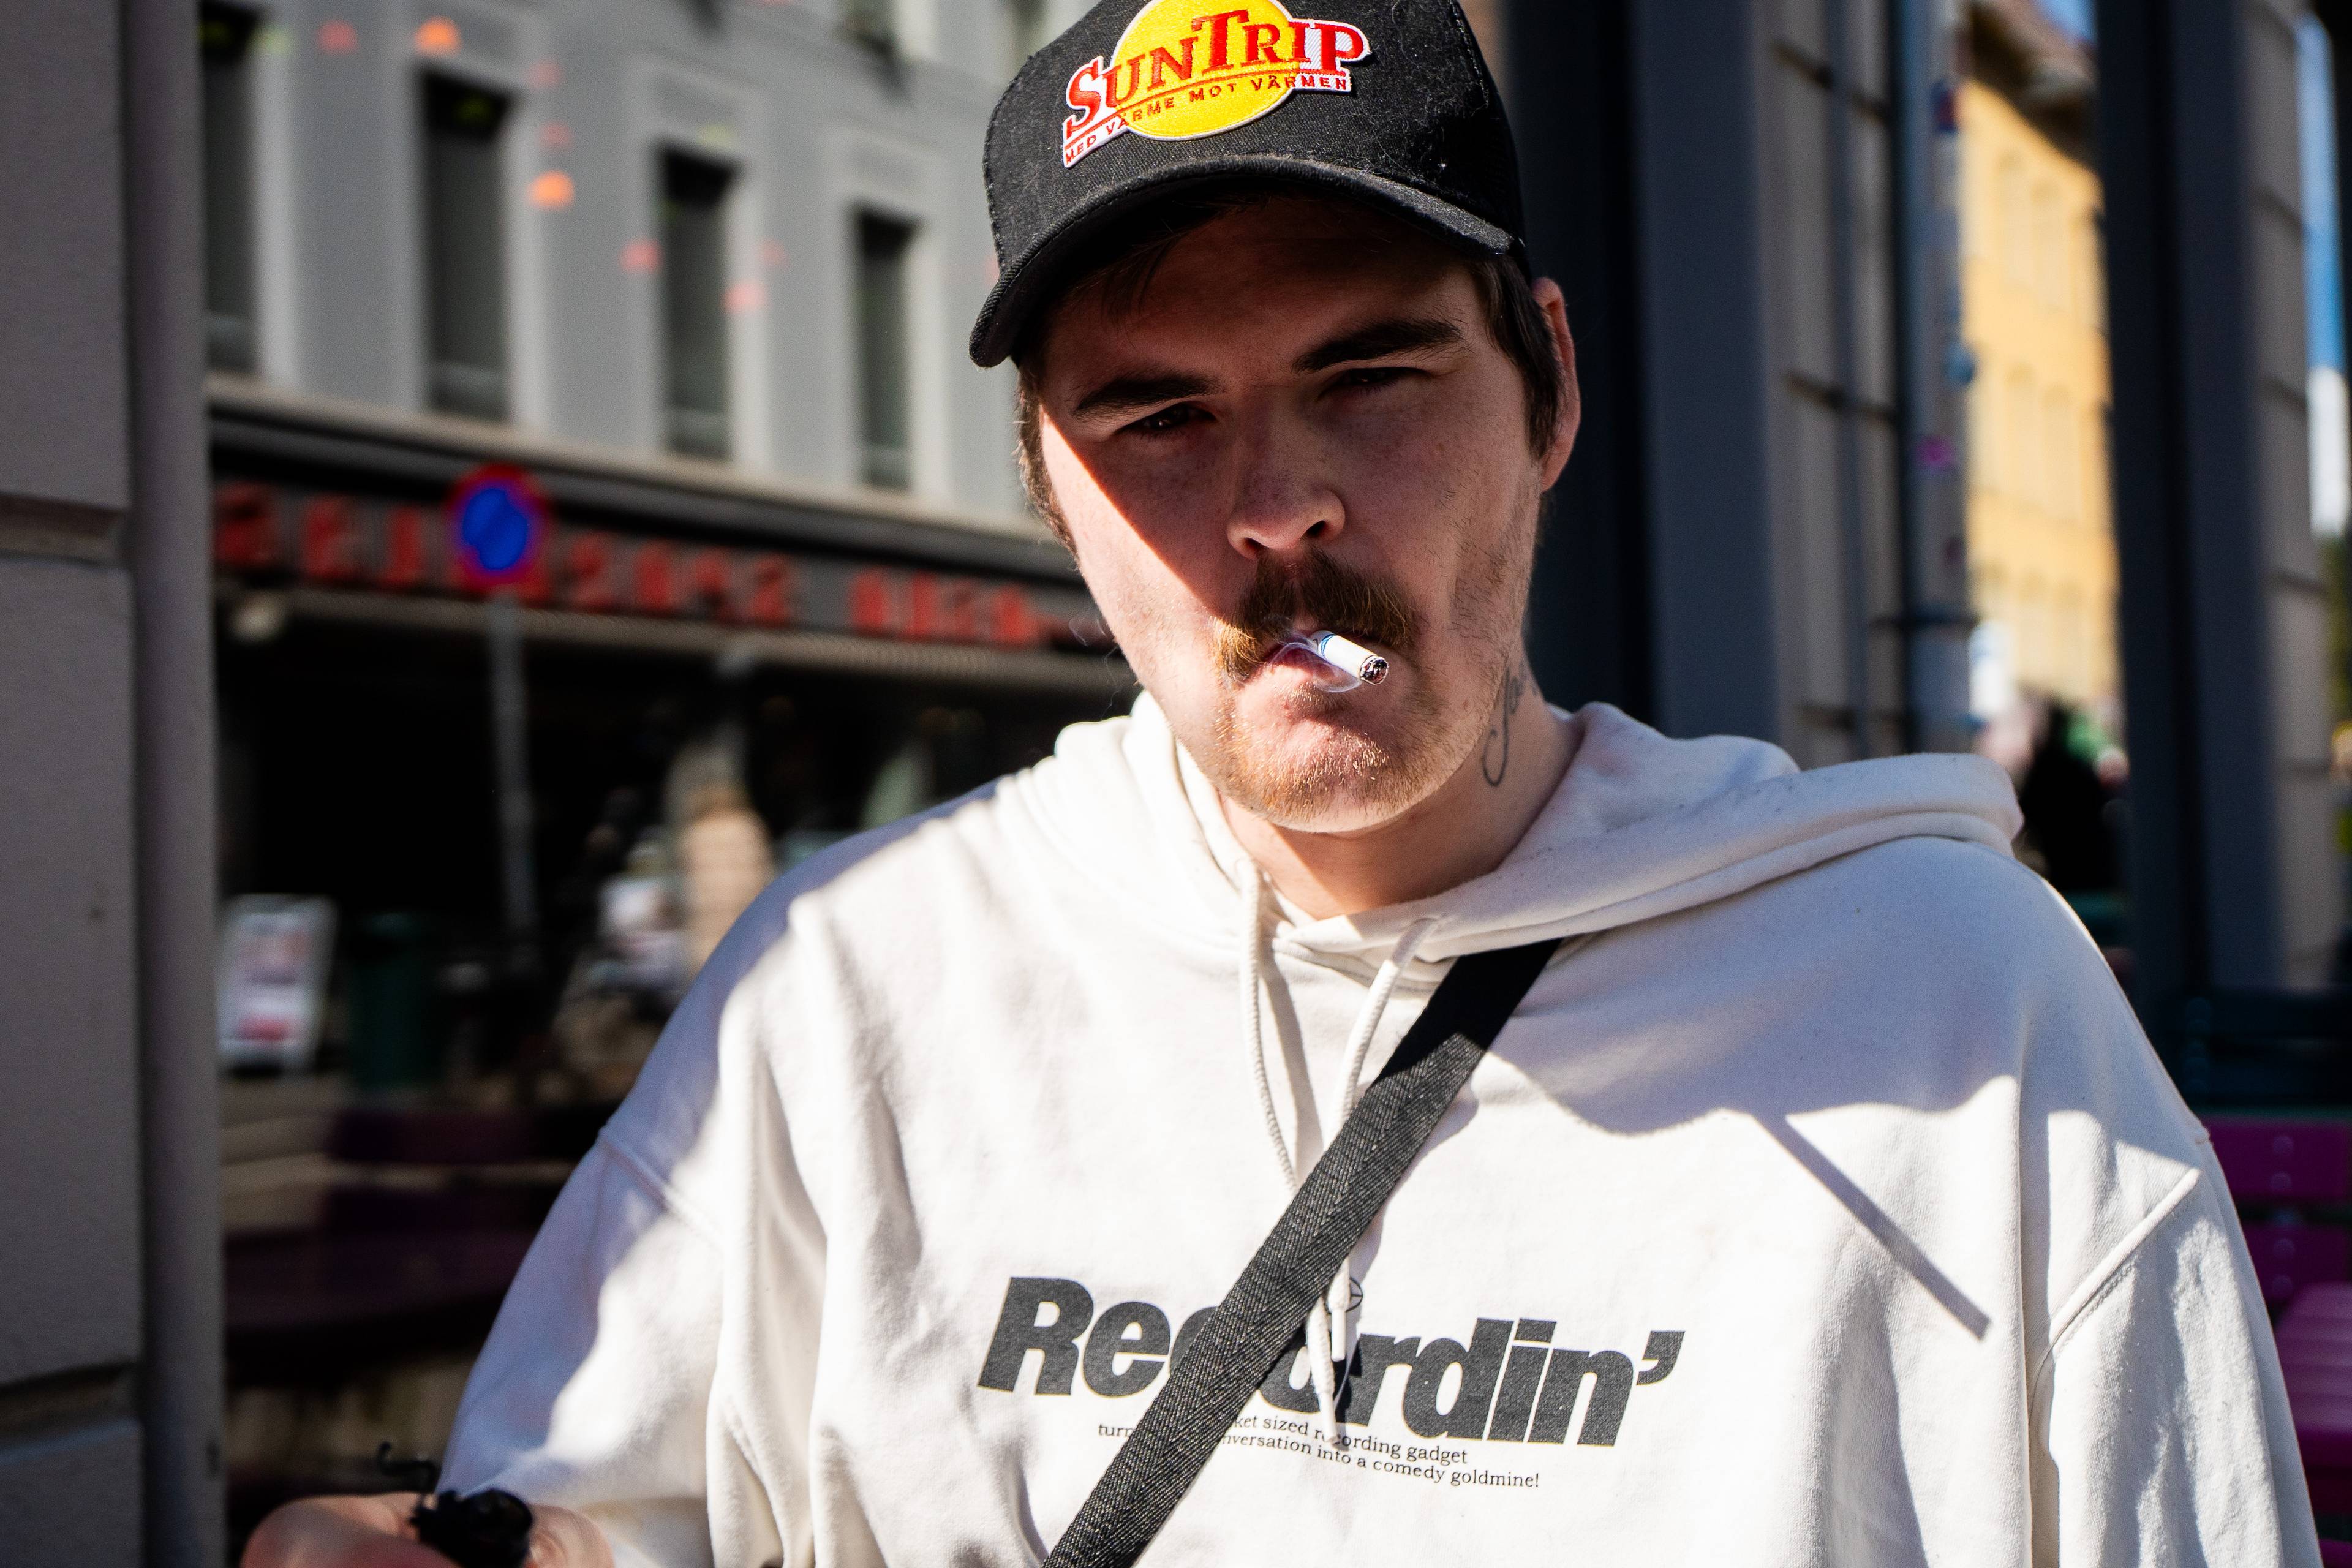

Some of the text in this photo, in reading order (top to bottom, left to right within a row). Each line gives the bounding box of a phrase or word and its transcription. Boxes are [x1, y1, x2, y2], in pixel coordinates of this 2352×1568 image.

[1066, 74, 1348, 165] MED VÄRME MOT VÄRMEN
[978, 1276, 1686, 1448] Rerdin’
[1221, 1434, 1312, 1455] nversation
[1317, 1446, 1351, 1464] into
[1356, 1457, 1367, 1468] a
[1373, 1460, 1446, 1483] comedy
[1450, 1469, 1540, 1488] goldmine!
[1262, 1415, 1309, 1436] sized
[1314, 1429, 1402, 1460] rording
[1406, 1446, 1468, 1467] gadget
